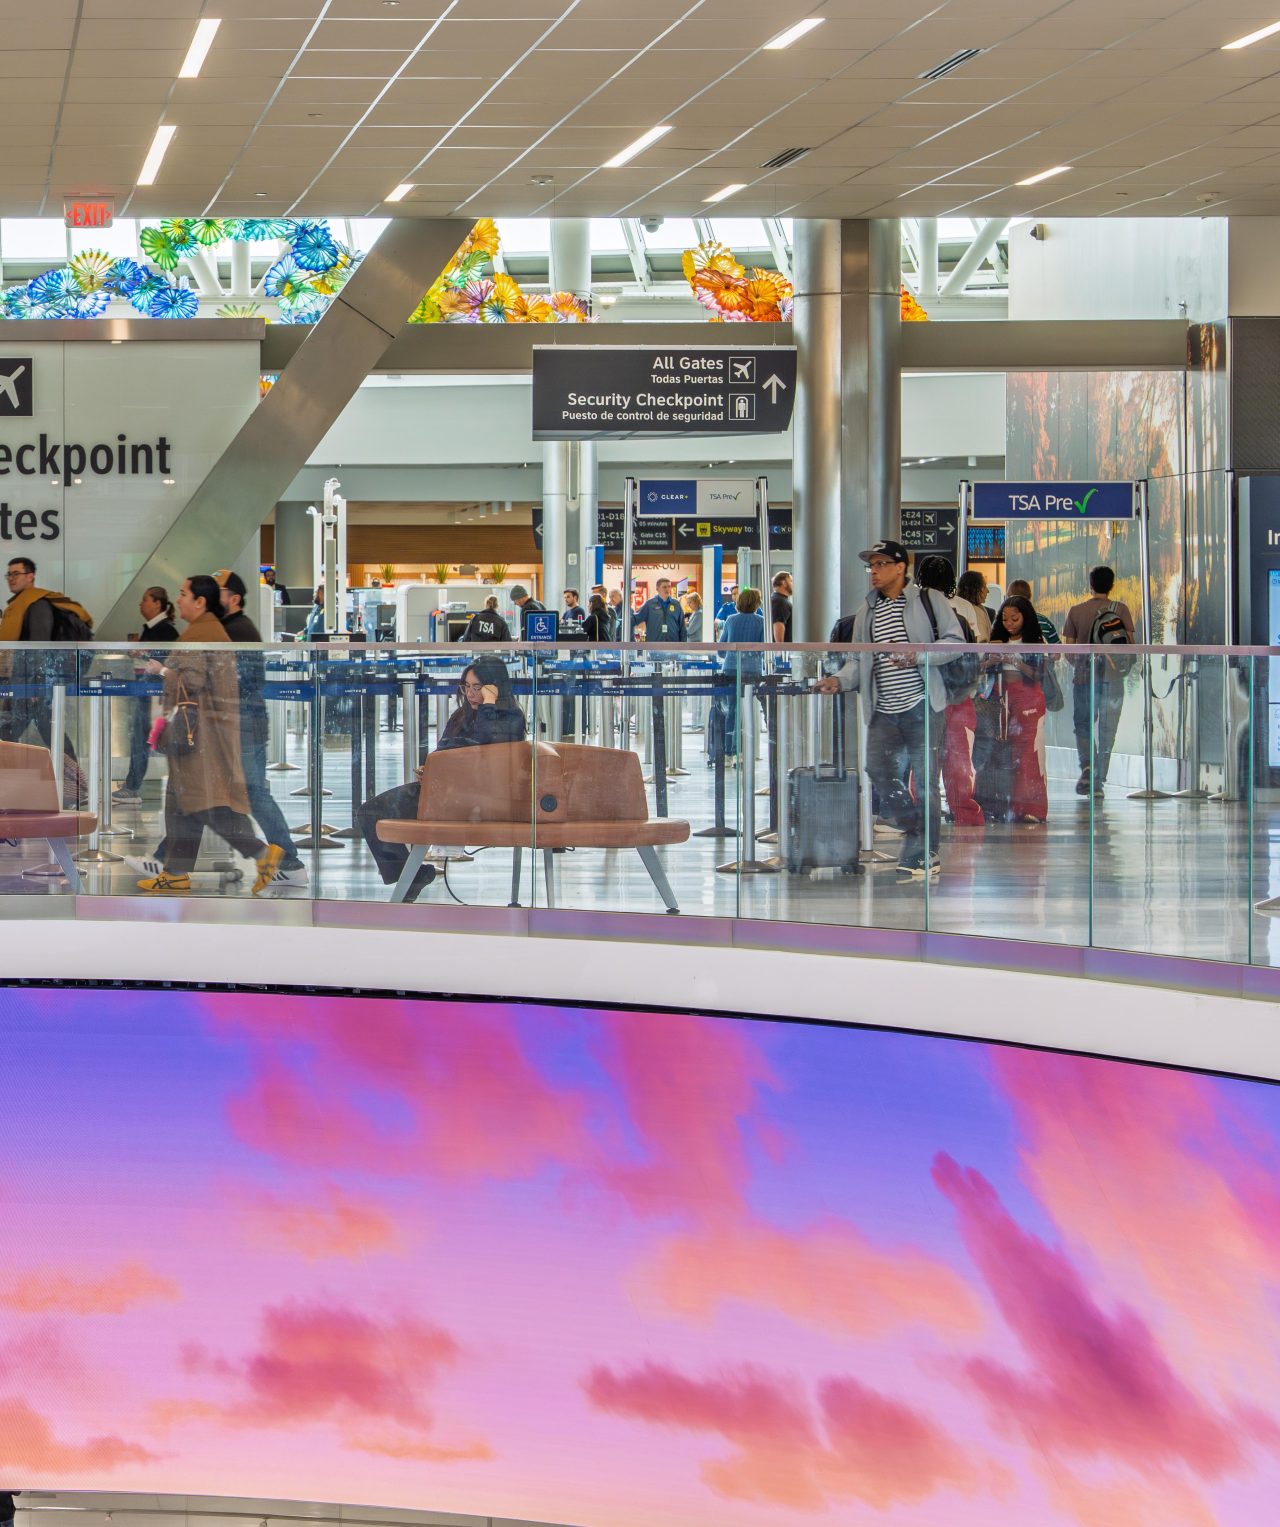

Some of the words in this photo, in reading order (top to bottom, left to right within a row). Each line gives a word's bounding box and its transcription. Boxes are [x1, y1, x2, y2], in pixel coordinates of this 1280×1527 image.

[73, 203, 107, 226] EXIT
[653, 356, 674, 370] All
[680, 356, 724, 370] Gates
[651, 374, 680, 384] Todas
[684, 374, 724, 384] Puertas
[568, 393, 631, 410] Security
[636, 393, 724, 410] Checkpoint
[562, 412, 598, 420] Puesto
[600, 411, 614, 420] de
[616, 411, 654, 420] control
[656, 411, 670, 420] de
[672, 411, 724, 422] seguridad
[1008, 495, 1040, 511] TSA
[1046, 495, 1073, 511] Pre
[713, 526, 742, 534] Skyway
[479, 620, 494, 634] TSA
